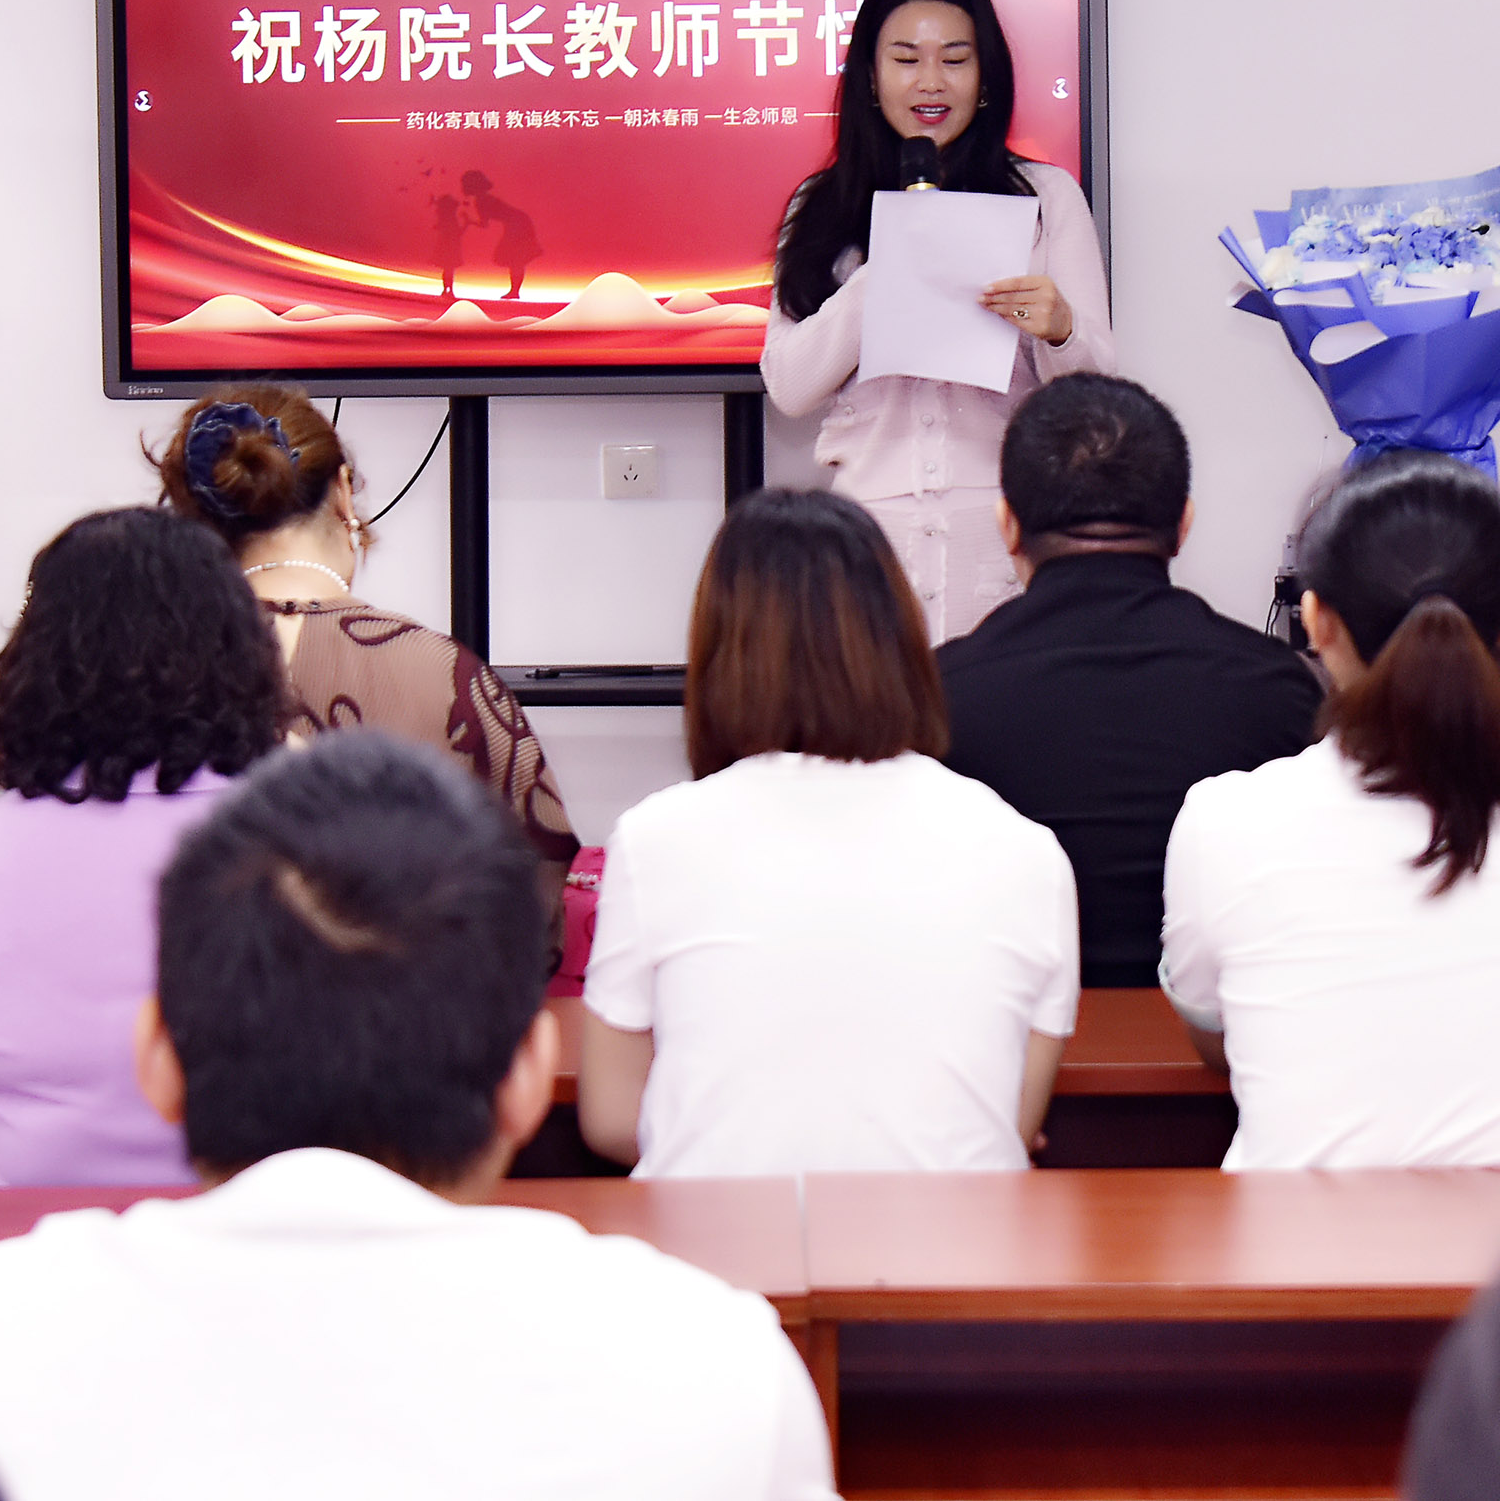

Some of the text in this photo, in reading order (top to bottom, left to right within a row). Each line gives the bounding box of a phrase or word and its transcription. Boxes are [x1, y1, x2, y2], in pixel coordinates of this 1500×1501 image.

[506, 109, 600, 128] 教诲终不忘
[704, 106, 798, 126] 一生念师恩
